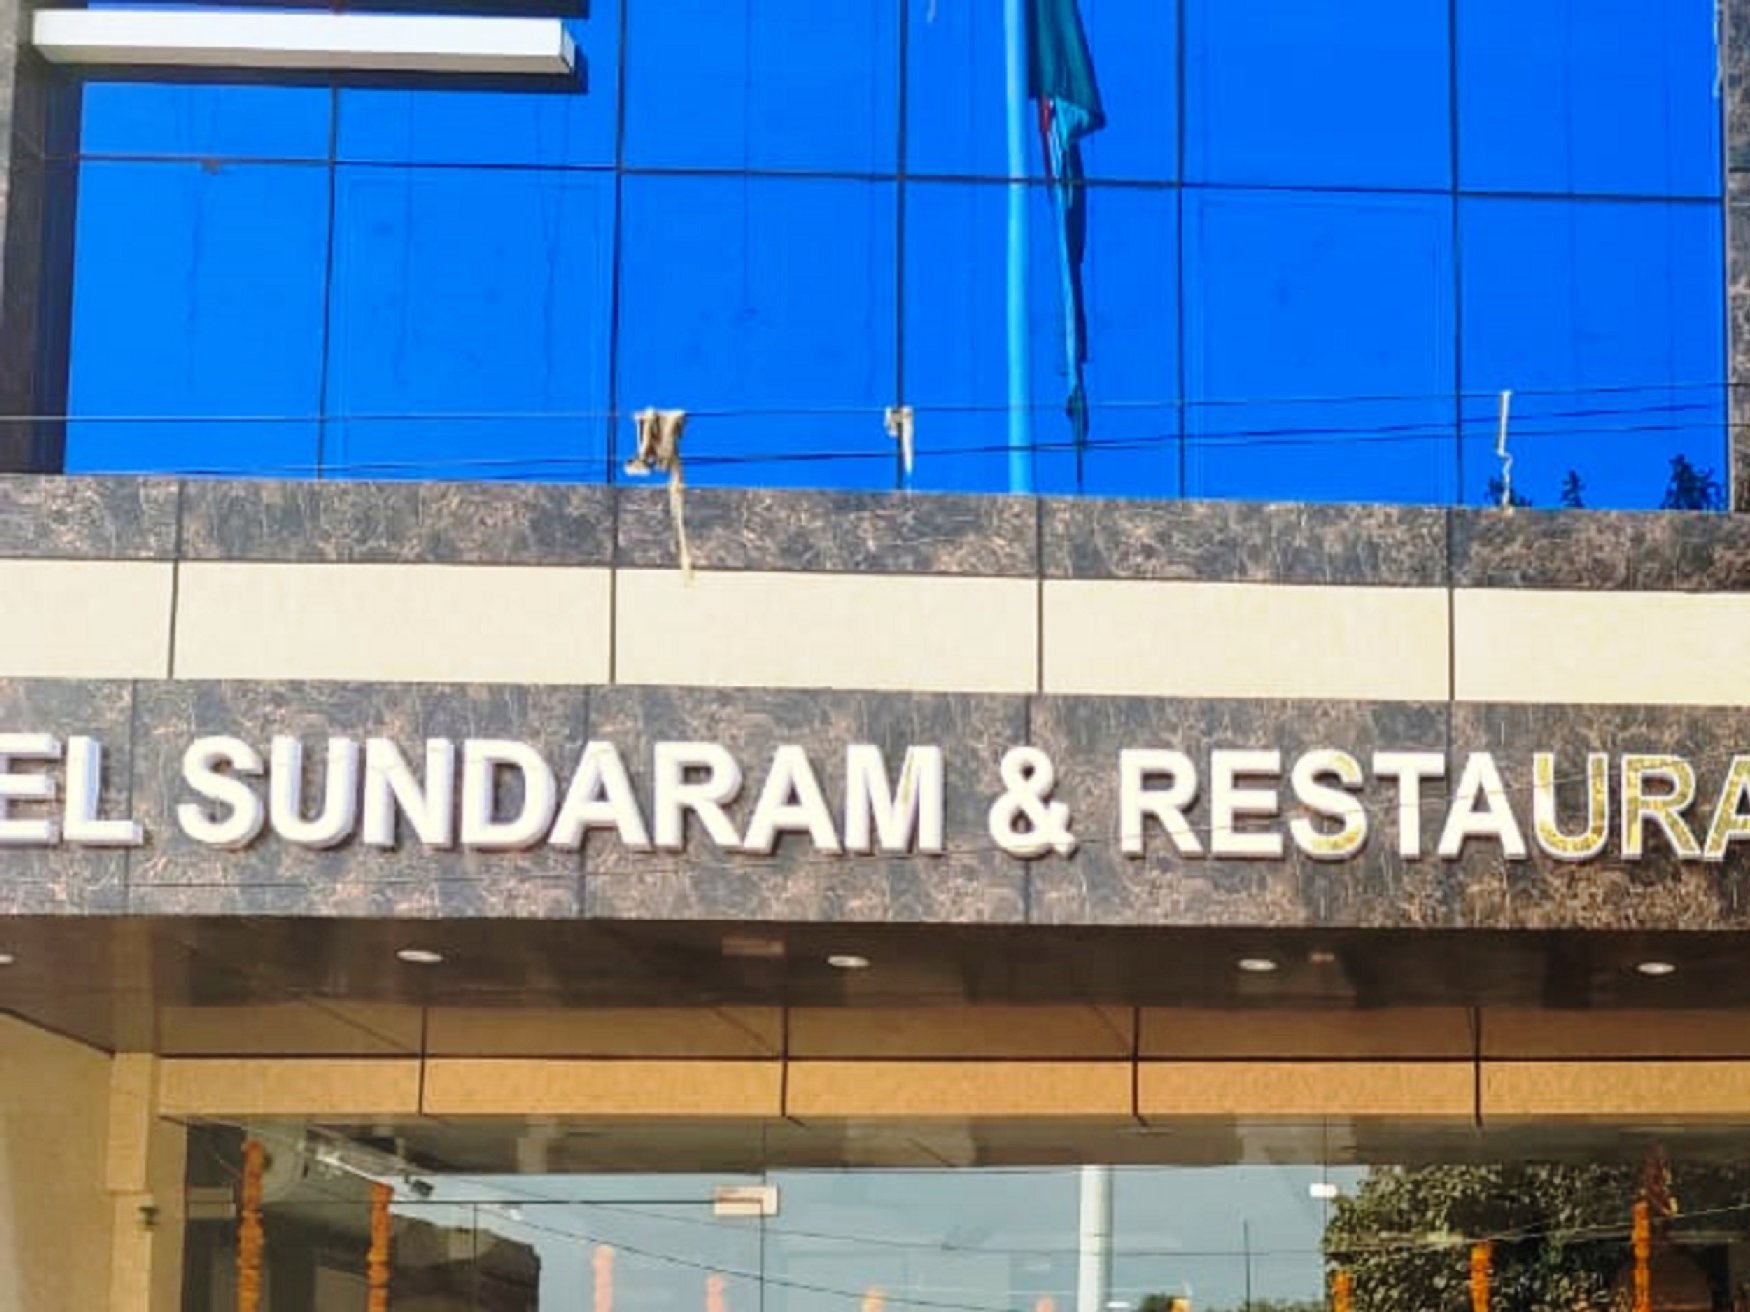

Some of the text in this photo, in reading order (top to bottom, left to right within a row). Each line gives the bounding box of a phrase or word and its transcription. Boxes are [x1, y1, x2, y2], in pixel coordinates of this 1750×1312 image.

[0, 732, 144, 845] EL
[178, 734, 944, 853] SUNDARAM
[989, 746, 1075, 859] &
